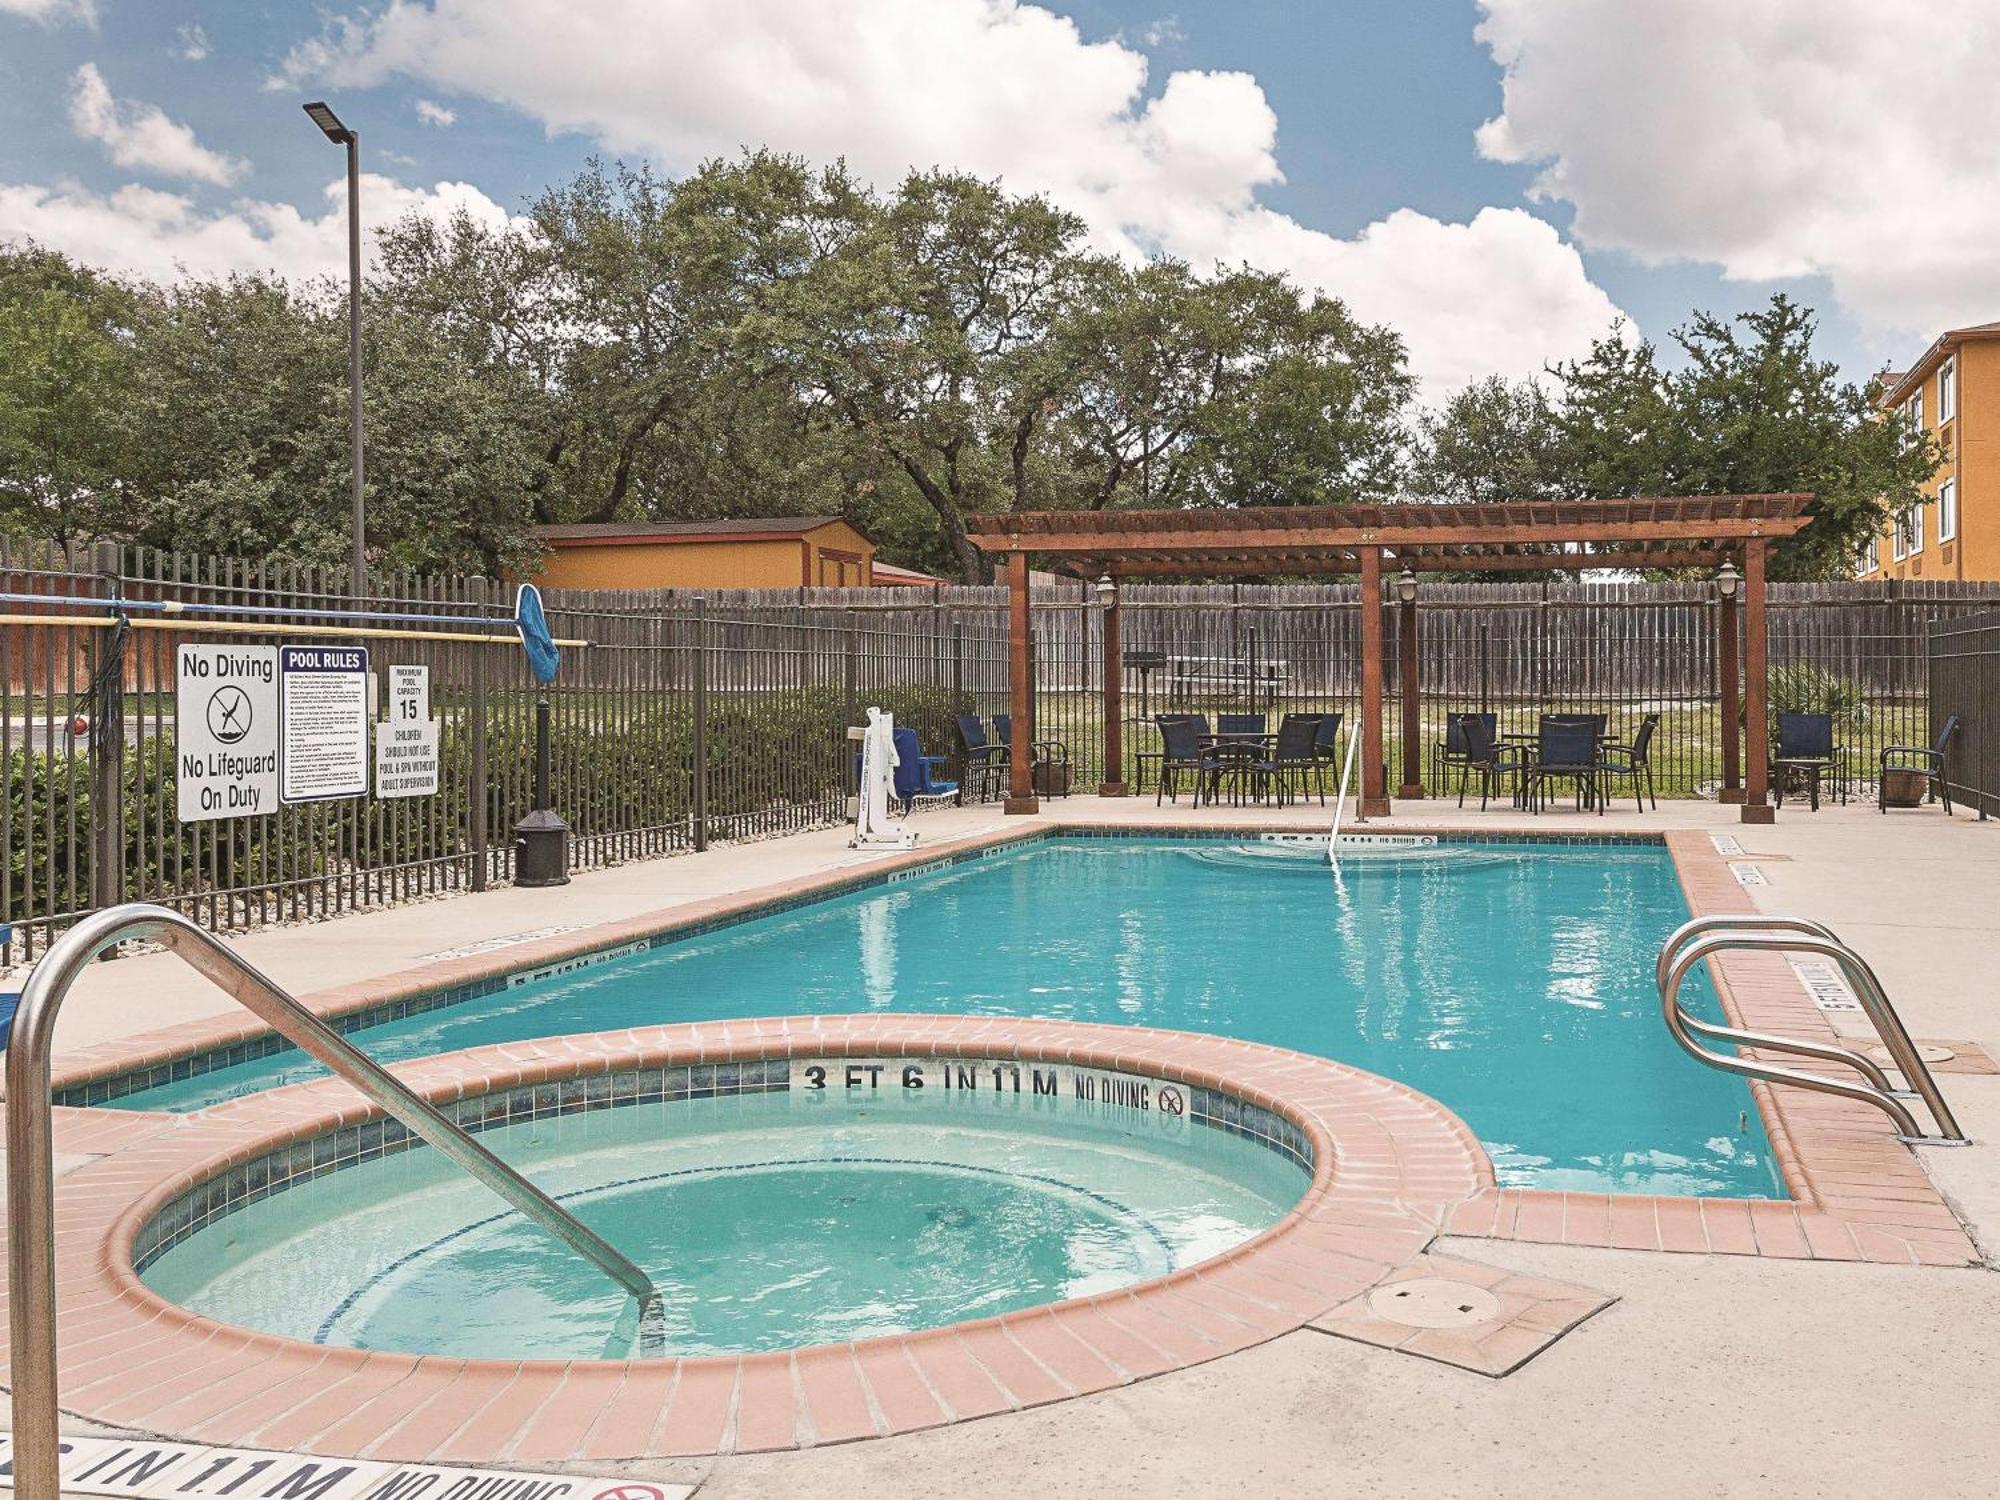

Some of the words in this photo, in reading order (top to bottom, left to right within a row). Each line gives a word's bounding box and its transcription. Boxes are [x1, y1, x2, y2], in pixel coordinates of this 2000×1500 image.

[183, 653, 209, 678] No
[216, 654, 273, 683] Diving
[289, 652, 321, 668] POOL
[323, 653, 360, 668] RULES
[396, 687, 421, 695] CAPACITY
[400, 700, 417, 719] 15
[420, 745, 430, 756] USE
[183, 754, 204, 779] No
[208, 750, 275, 781] Lifeguard
[379, 763, 394, 774] POOL
[401, 762, 411, 773] SPA
[381, 778, 398, 791] ADULT
[201, 786, 222, 811] On
[228, 785, 261, 812] Duty
[804, 1065, 827, 1089] 3
[846, 1064, 885, 1089] FT
[902, 1064, 924, 1089] 6
[944, 1064, 977, 1090] IN
[1033, 1069, 1058, 1097] M
[1076, 1073, 1094, 1102] NO
[1102, 1078, 1149, 1110] DIVING
[73, 1447, 186, 1487] IN
[261, 1463, 358, 1500] M
[365, 1471, 440, 1500] NO
